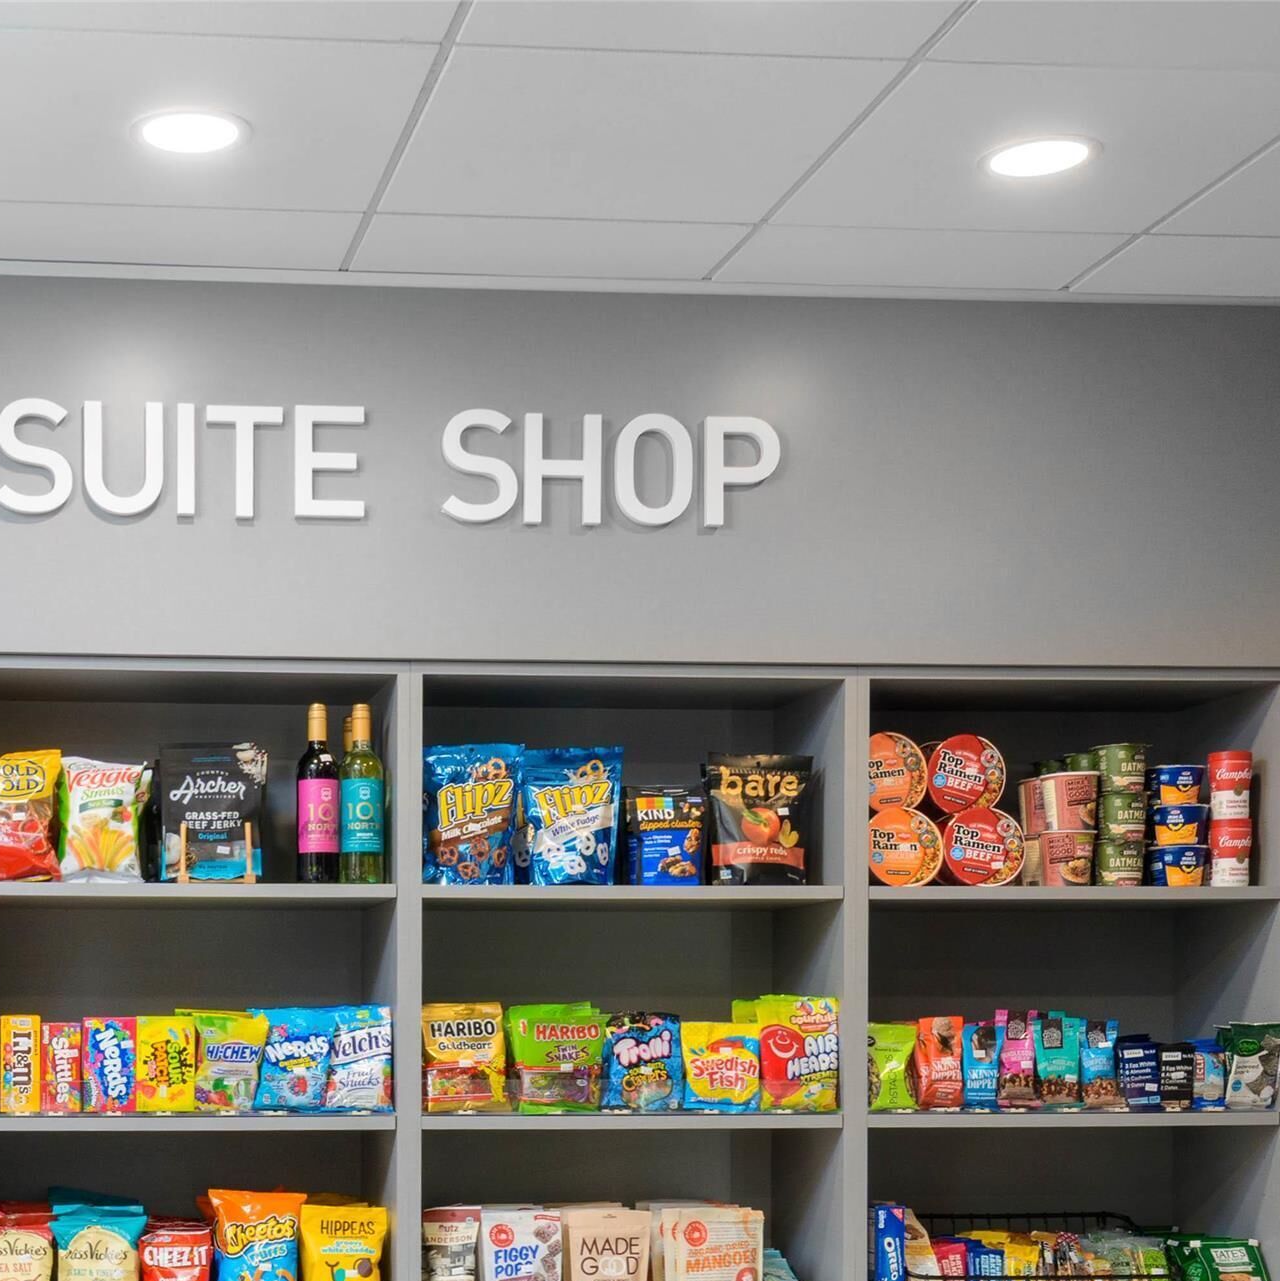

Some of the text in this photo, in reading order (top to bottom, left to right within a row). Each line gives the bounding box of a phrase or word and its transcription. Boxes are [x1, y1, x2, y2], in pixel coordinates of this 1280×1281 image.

[440, 408, 782, 528] SHOP
[941, 750, 964, 767] Top
[720, 766, 799, 797] bare
[937, 762, 982, 783] Ramen
[170, 775, 246, 804] Archer
[947, 777, 974, 791] BEEF
[185, 811, 239, 820] GRASS-FED
[211, 819, 243, 829] JERKY
[638, 809, 675, 821] KIND
[871, 829, 895, 841] Top
[954, 825, 979, 839] Top
[954, 835, 1001, 853] Ramen
[966, 850, 992, 861] BEEF
[430, 1020, 496, 1038] HARIBO
[535, 1024, 601, 1041] HARIBO
[206, 1044, 263, 1063] HI-CHEW
[613, 1030, 672, 1066] Trolli
[167, 1041, 182, 1085] SOUR
[690, 1056, 759, 1078] Swedish
[786, 1053, 839, 1080] HEADS
[707, 1071, 748, 1090] Fish
[320, 1220, 376, 1235] HIPPEAS
[494, 1244, 539, 1265] FIGGY
[580, 1237, 640, 1256] MADE
[581, 1256, 639, 1276] GOOD
[883, 1236, 899, 1281] OREO
